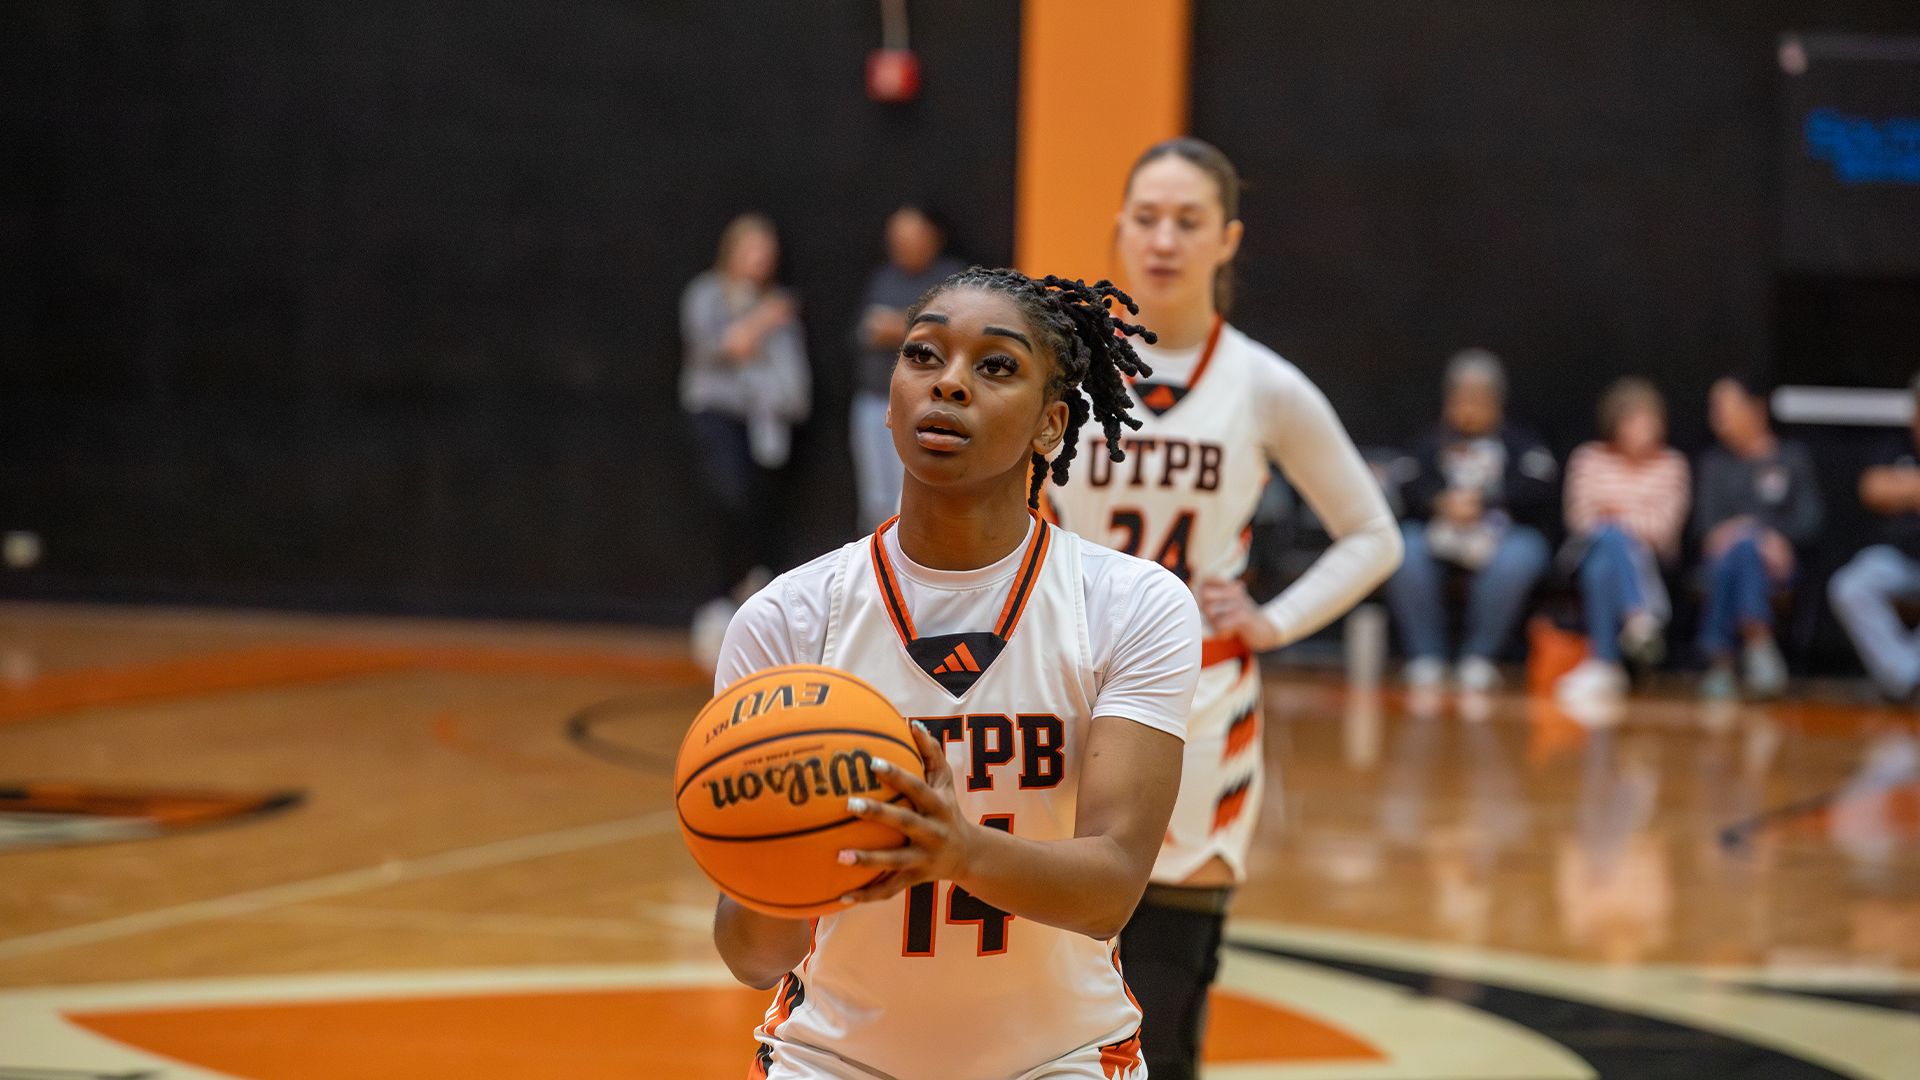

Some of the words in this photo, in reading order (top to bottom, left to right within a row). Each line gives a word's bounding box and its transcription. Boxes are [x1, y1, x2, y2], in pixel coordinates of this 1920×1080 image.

[1089, 438, 1222, 491] UTPB
[730, 682, 831, 727] EVO
[704, 719, 730, 746] NXT
[902, 713, 1065, 792] TPB
[708, 748, 882, 809] Wilson
